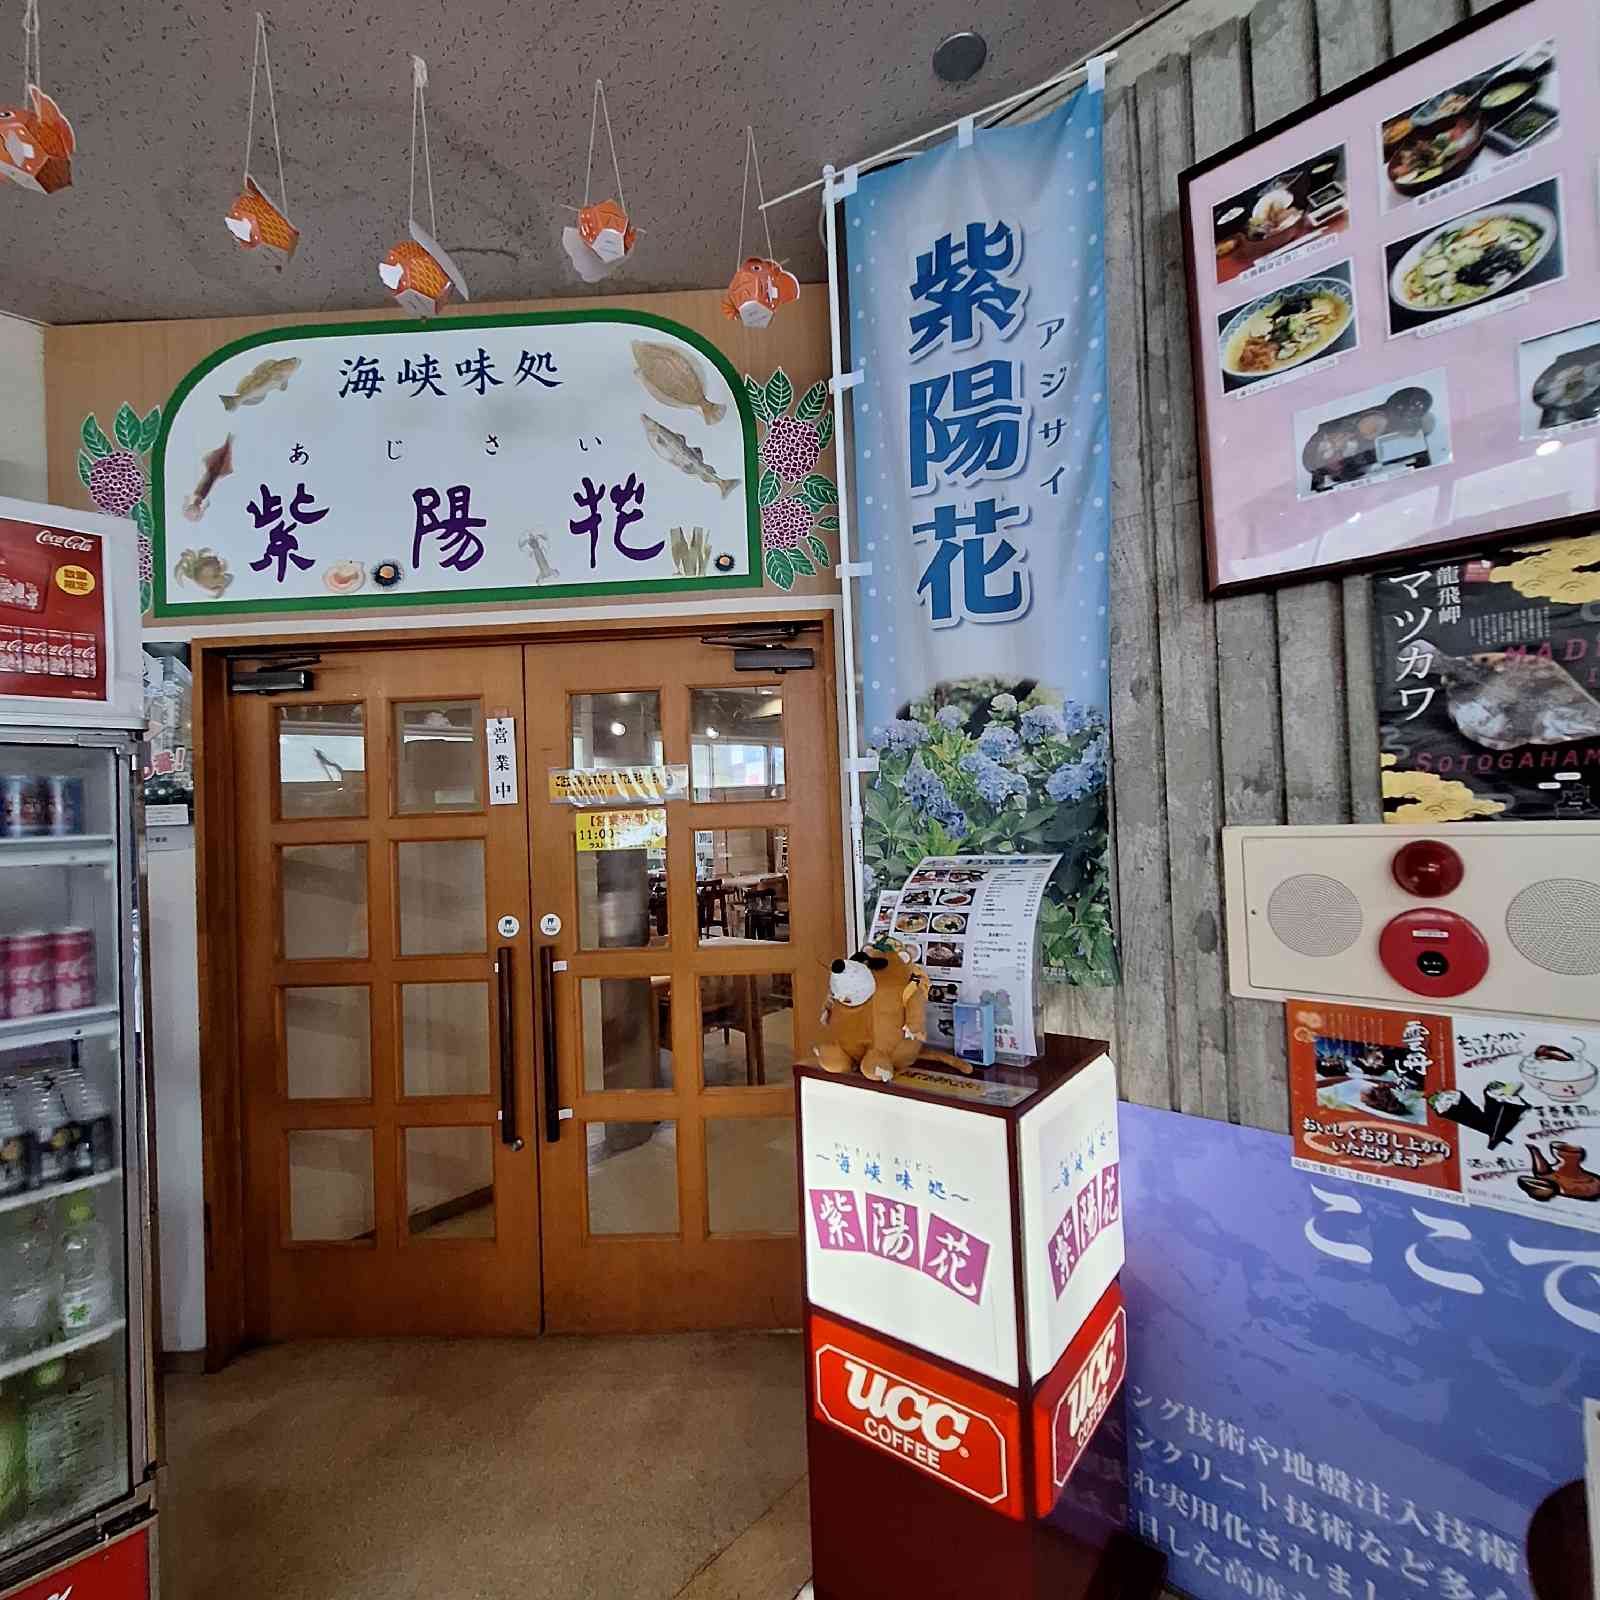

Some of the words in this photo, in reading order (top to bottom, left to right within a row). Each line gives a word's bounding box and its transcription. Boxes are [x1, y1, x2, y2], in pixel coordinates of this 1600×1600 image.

[338, 347, 563, 400] 海峡味処
[909, 220, 1022, 621] 紫陽花
[1036, 317, 1067, 496] アジサイ
[246, 473, 665, 582] 紫陽花
[1388, 569, 1436, 721] マツカワ
[494, 727, 512, 799] 営業中
[1303, 1117, 1452, 1159] おいしくお召し上がり
[1331, 1141, 1424, 1168] いただけます
[818, 1191, 978, 1297] 紫陽花
[1055, 1165, 1120, 1287] 紫陽花
[844, 1359, 970, 1451] UCC
[863, 1415, 941, 1471] COFFEE
